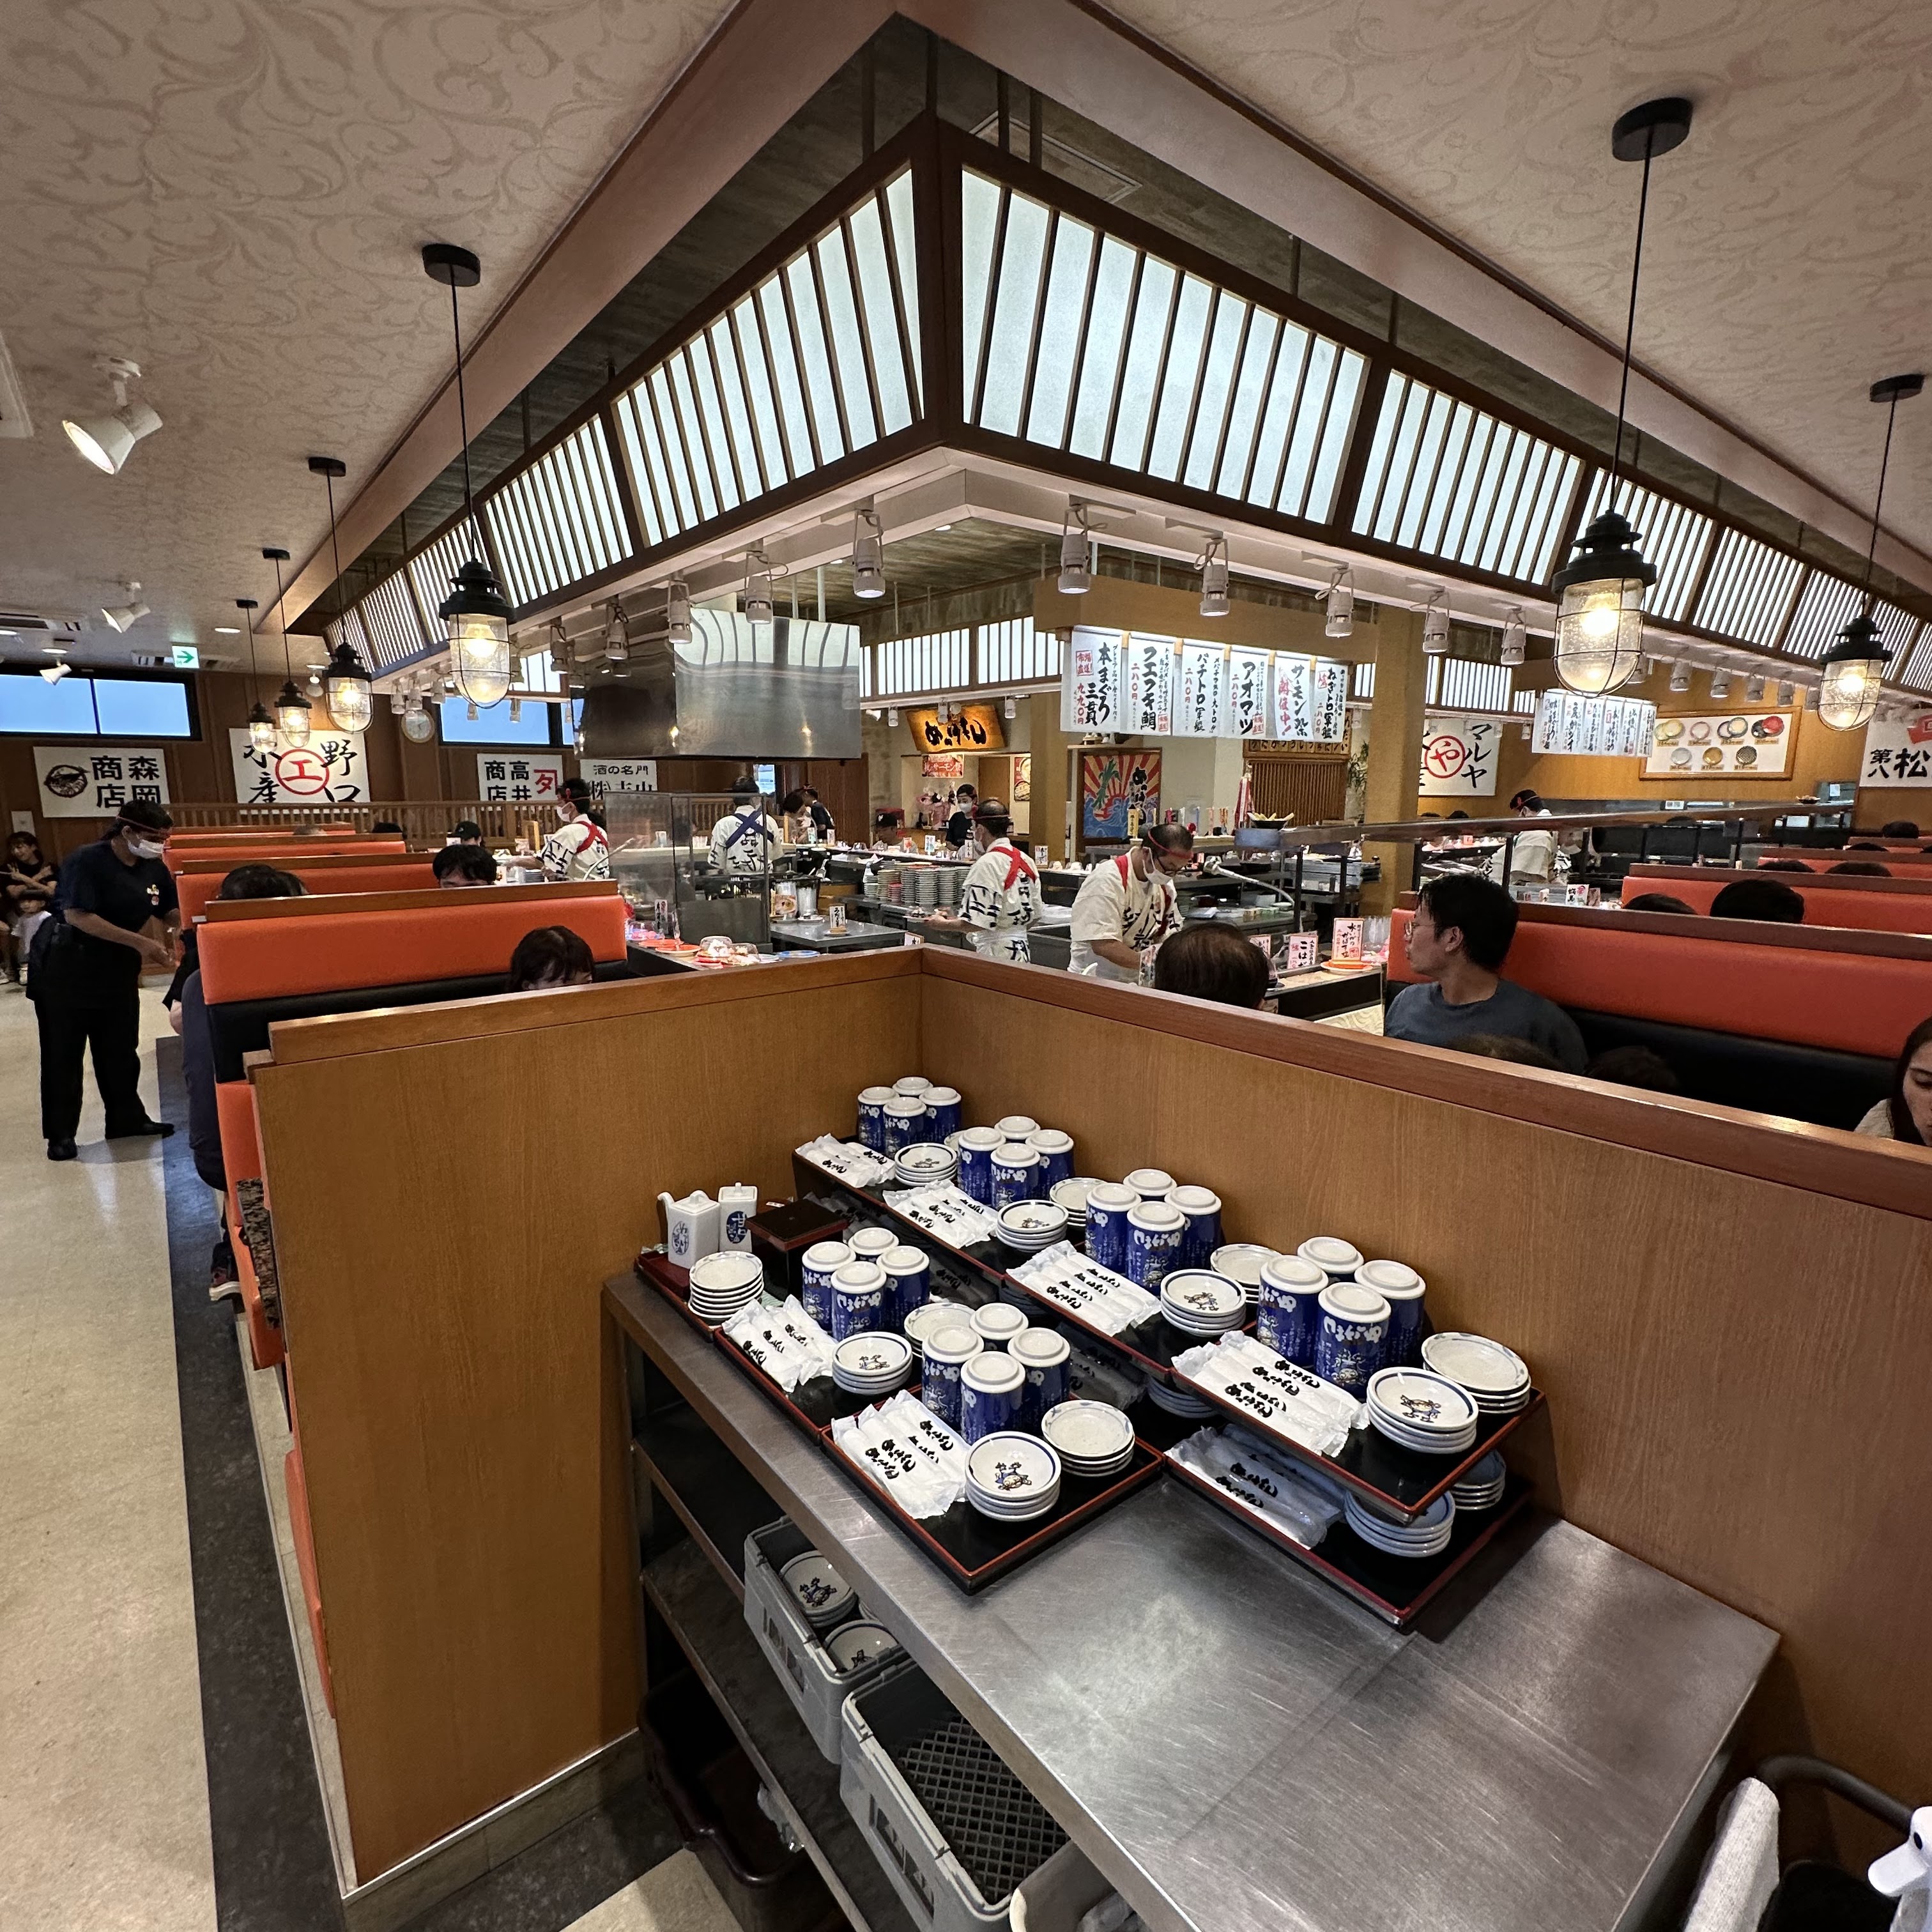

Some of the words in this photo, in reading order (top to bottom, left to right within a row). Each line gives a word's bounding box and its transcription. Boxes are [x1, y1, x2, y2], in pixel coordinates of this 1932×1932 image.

[1097, 641, 1112, 724] 本まぐろ
[1239, 661, 1256, 735] アオマツ
[1291, 664, 1309, 737] サーモン祭
[128, 756, 160, 804] 森岡
[484, 760, 507, 801] 商店
[509, 760, 532, 801] 高井
[594, 765, 648, 776] 酒の名門
[1461, 723, 1492, 788] マルヤ
[90, 755, 125, 808] 商店
[804, 1271, 831, 1289] めっけも
